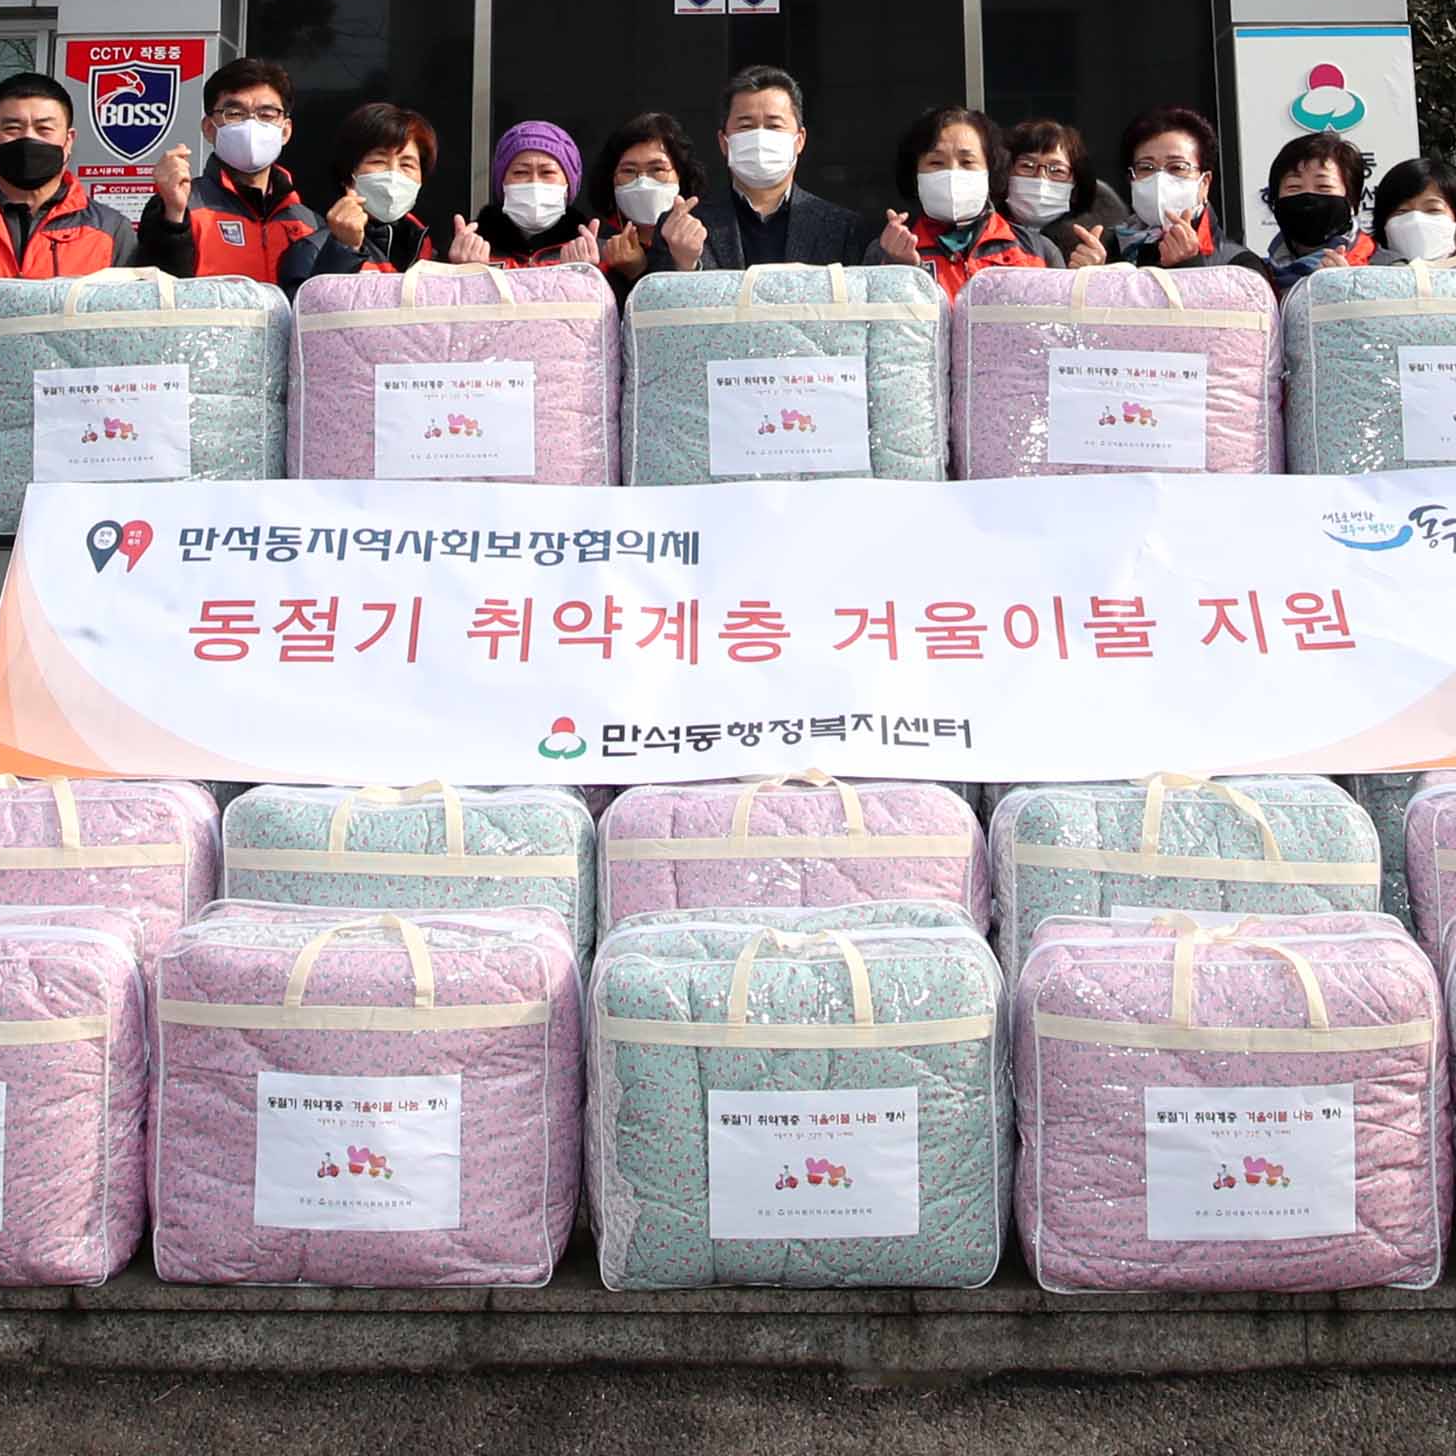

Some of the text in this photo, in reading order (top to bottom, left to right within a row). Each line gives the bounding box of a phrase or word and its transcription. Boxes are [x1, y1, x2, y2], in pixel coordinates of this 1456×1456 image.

[90, 46, 181, 60] CCTV 작동중
[101, 103, 167, 126] BOSS
[179, 524, 699, 565] 만석동지역사회보장협의체
[189, 589, 1356, 664] 동절기 취약계층 겨울이불 지원
[601, 714, 972, 757] 만석동행정복지센터
